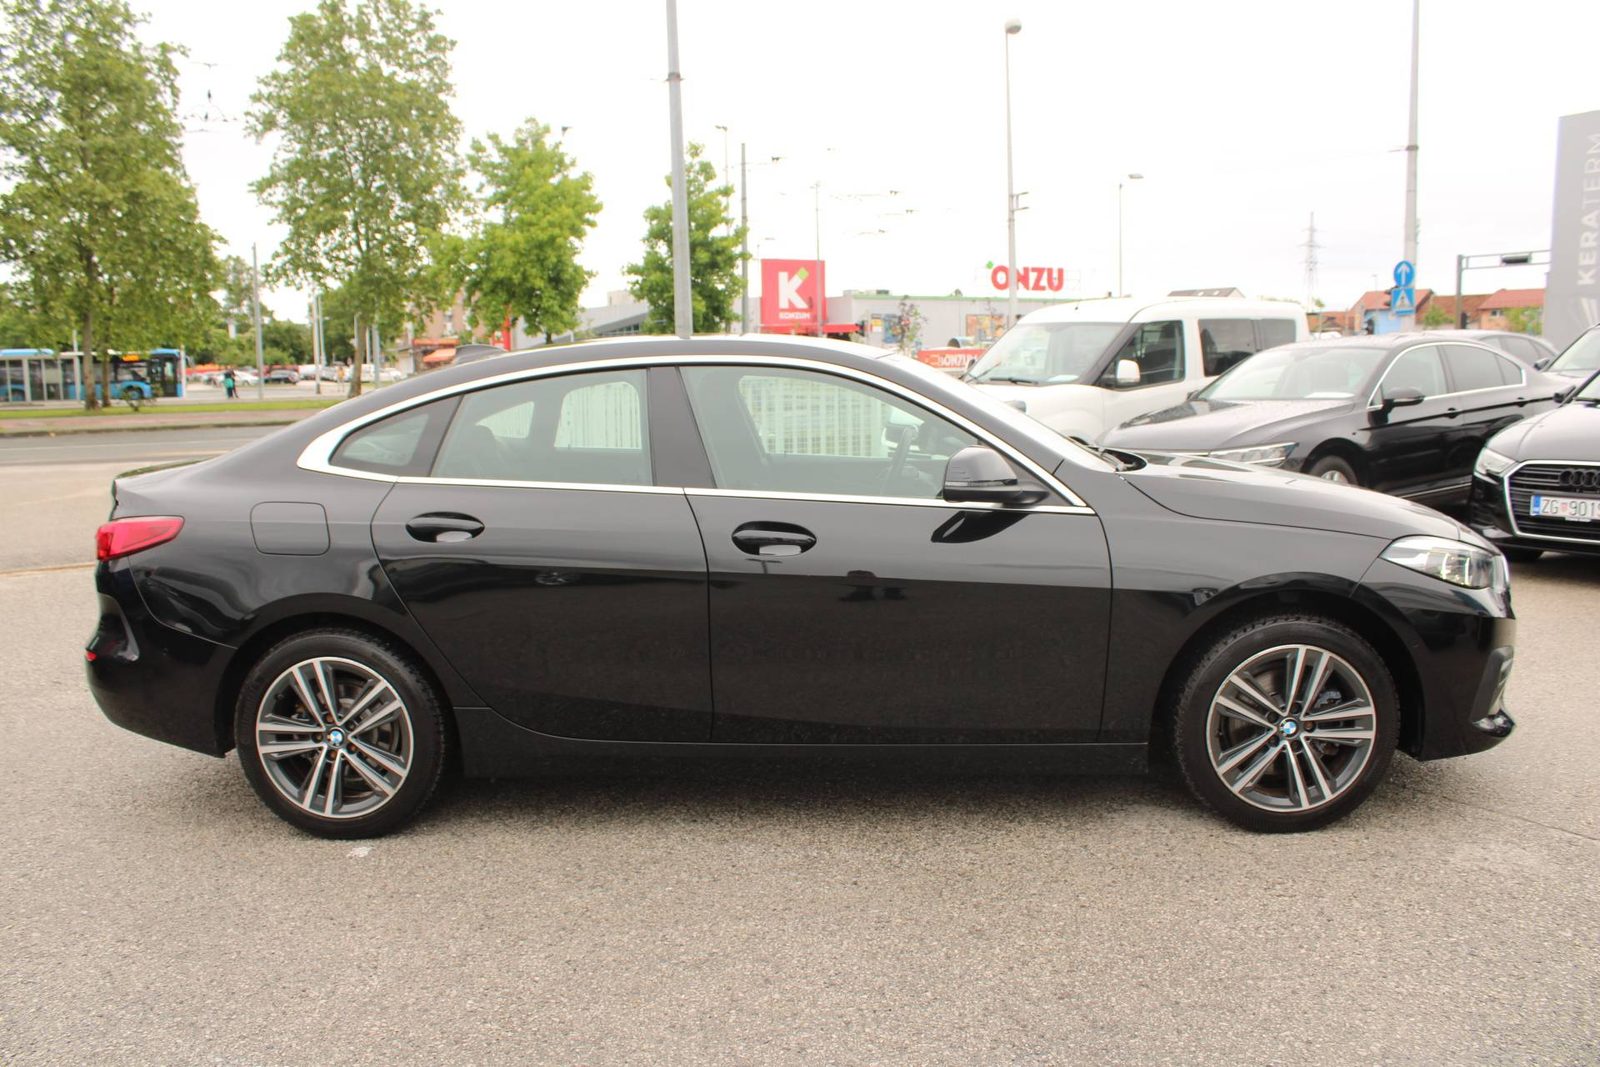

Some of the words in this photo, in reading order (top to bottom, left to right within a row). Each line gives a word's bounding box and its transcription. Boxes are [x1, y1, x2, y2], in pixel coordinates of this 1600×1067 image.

[1577, 133, 1600, 286] KERATERM
[1542, 499, 1559, 514] ZG
[1569, 501, 1600, 517] 901
